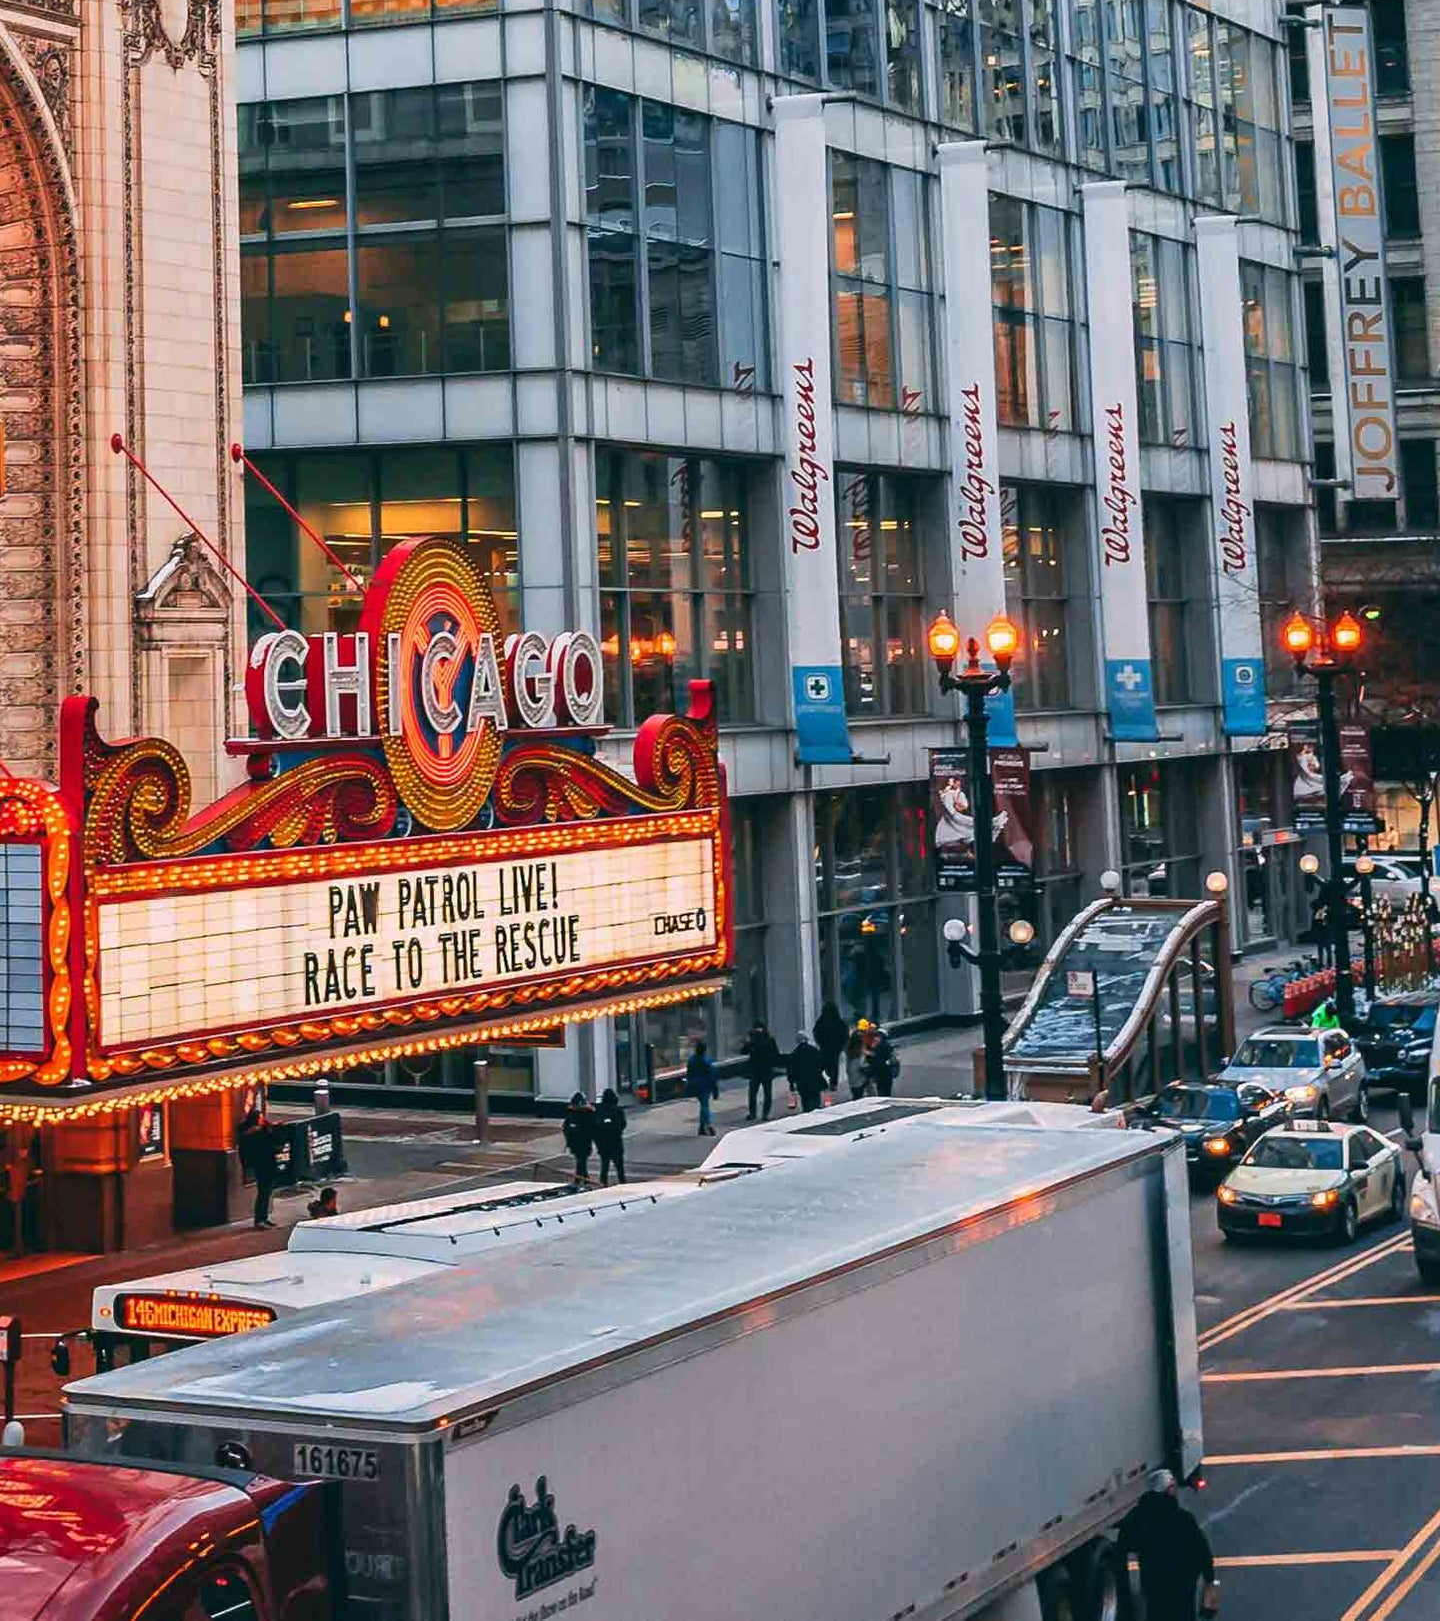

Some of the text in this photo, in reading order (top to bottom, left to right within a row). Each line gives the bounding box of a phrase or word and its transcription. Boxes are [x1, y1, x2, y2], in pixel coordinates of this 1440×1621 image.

[1327, 14, 1395, 492] JOFFREY BALLET
[792, 357, 829, 555] Walgreens
[961, 382, 995, 563] Walgreens
[1099, 402, 1137, 568] Walgreens
[1223, 421, 1251, 574] Walgreens
[262, 628, 604, 740] CHICAGO
[329, 862, 558, 939] PAW PATROL LIVE!
[653, 912, 695, 936] CHASE
[304, 915, 581, 1005] RACE TO THE RESCUE
[154, 1304, 212, 1330] MICHIGAN
[297, 1445, 377, 1479] 161675
